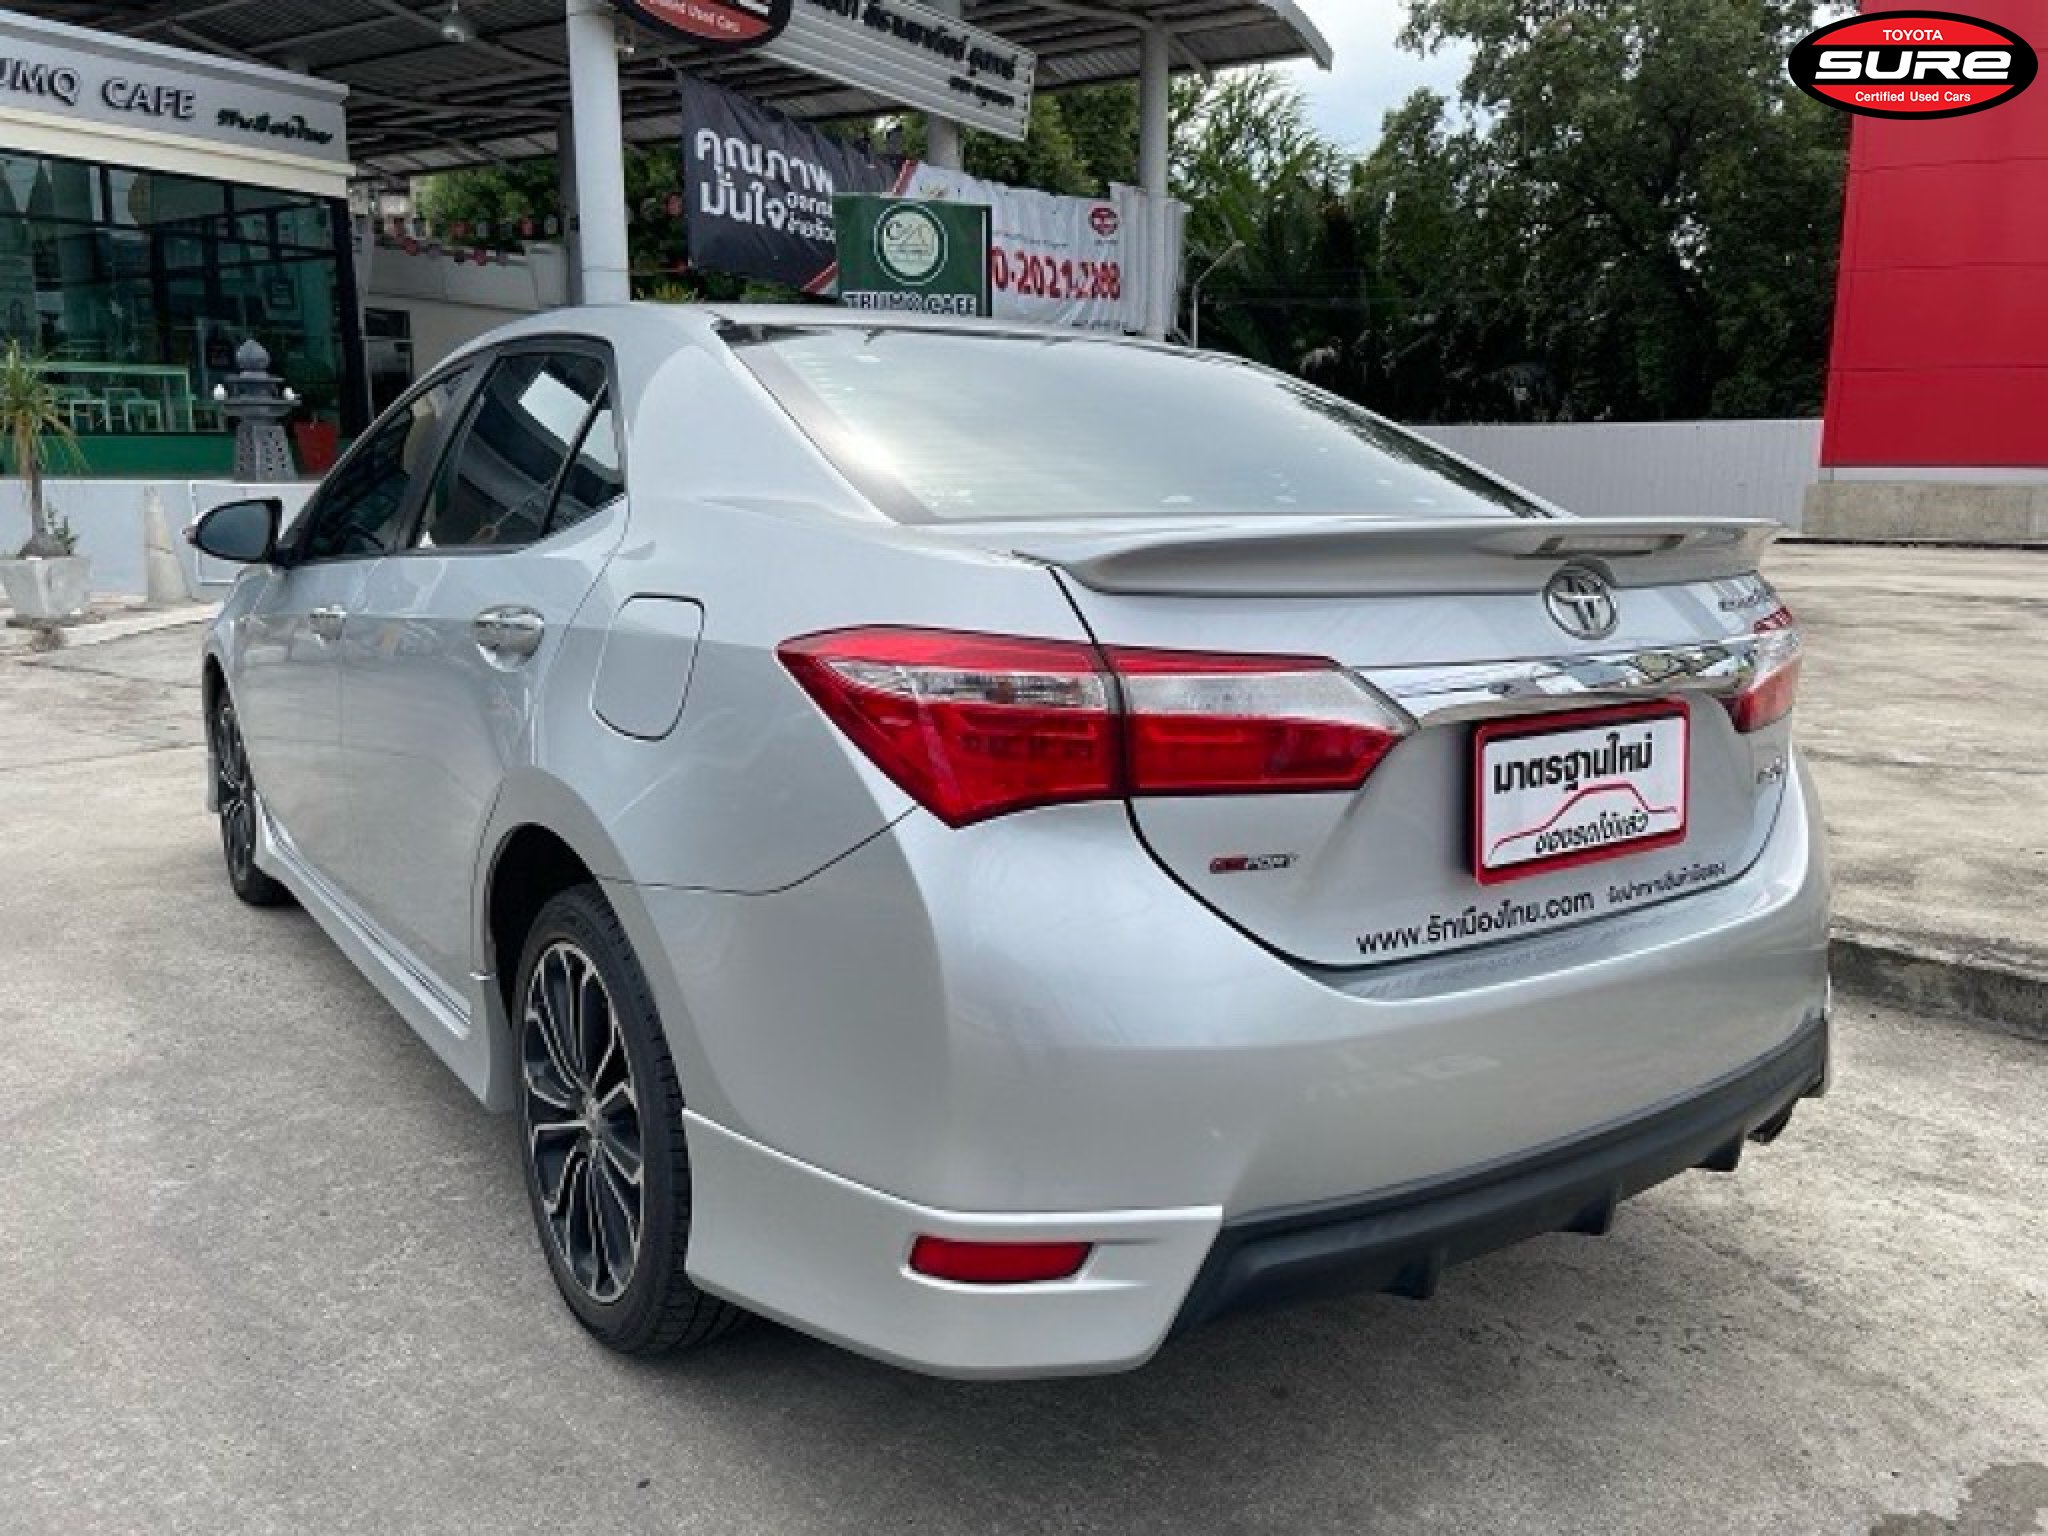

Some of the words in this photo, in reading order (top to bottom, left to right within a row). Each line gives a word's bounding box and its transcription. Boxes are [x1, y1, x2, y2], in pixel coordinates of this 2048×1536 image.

[101, 78, 195, 120] CAFE
[695, 127, 834, 194] คุณภาพ
[700, 170, 788, 231] มั่นใจ
[1493, 732, 1653, 794] มาตรฐานใหม่
